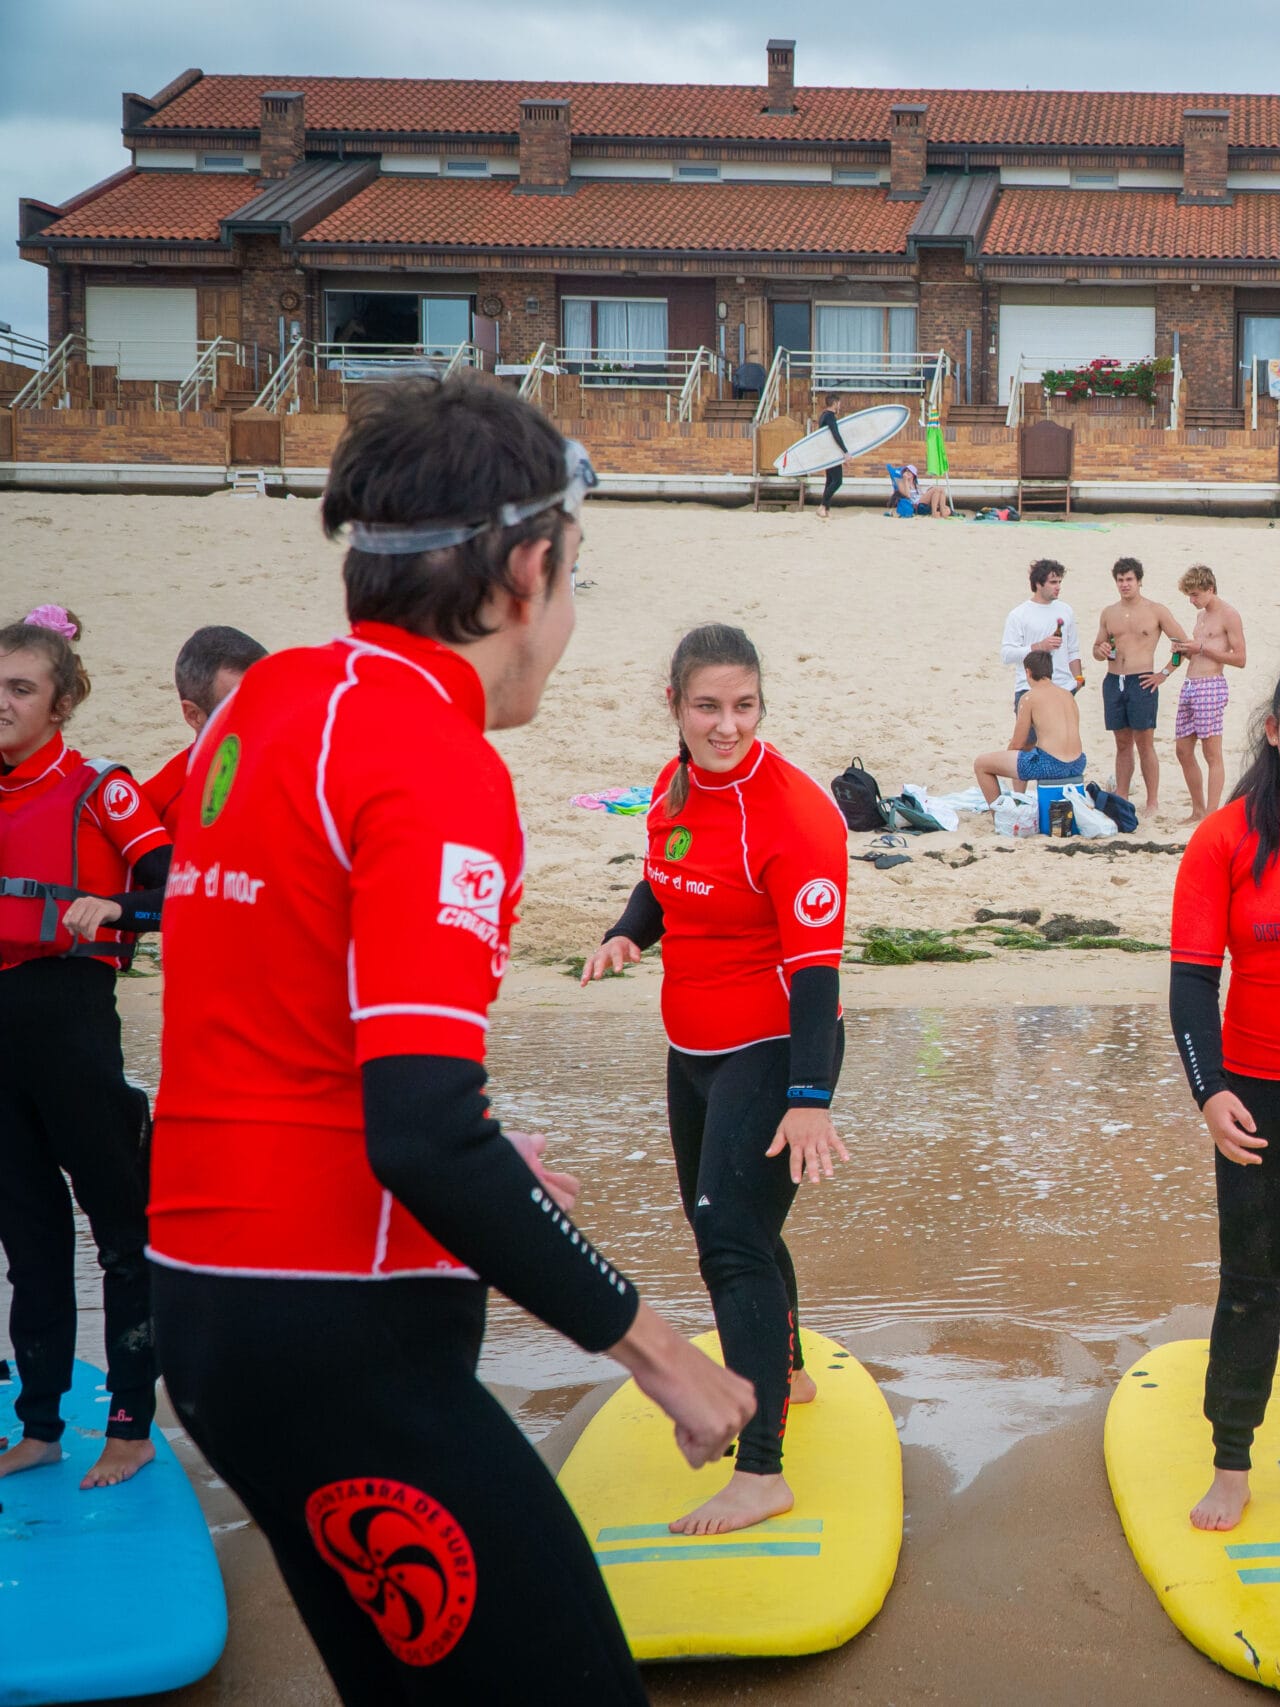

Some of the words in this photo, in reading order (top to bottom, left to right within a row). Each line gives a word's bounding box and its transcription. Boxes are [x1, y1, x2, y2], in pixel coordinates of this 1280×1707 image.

[223, 870, 266, 905] mar
[686, 880, 714, 896] mar
[413, 1498, 442, 1525] DE
[438, 1524, 471, 1578] SURF
